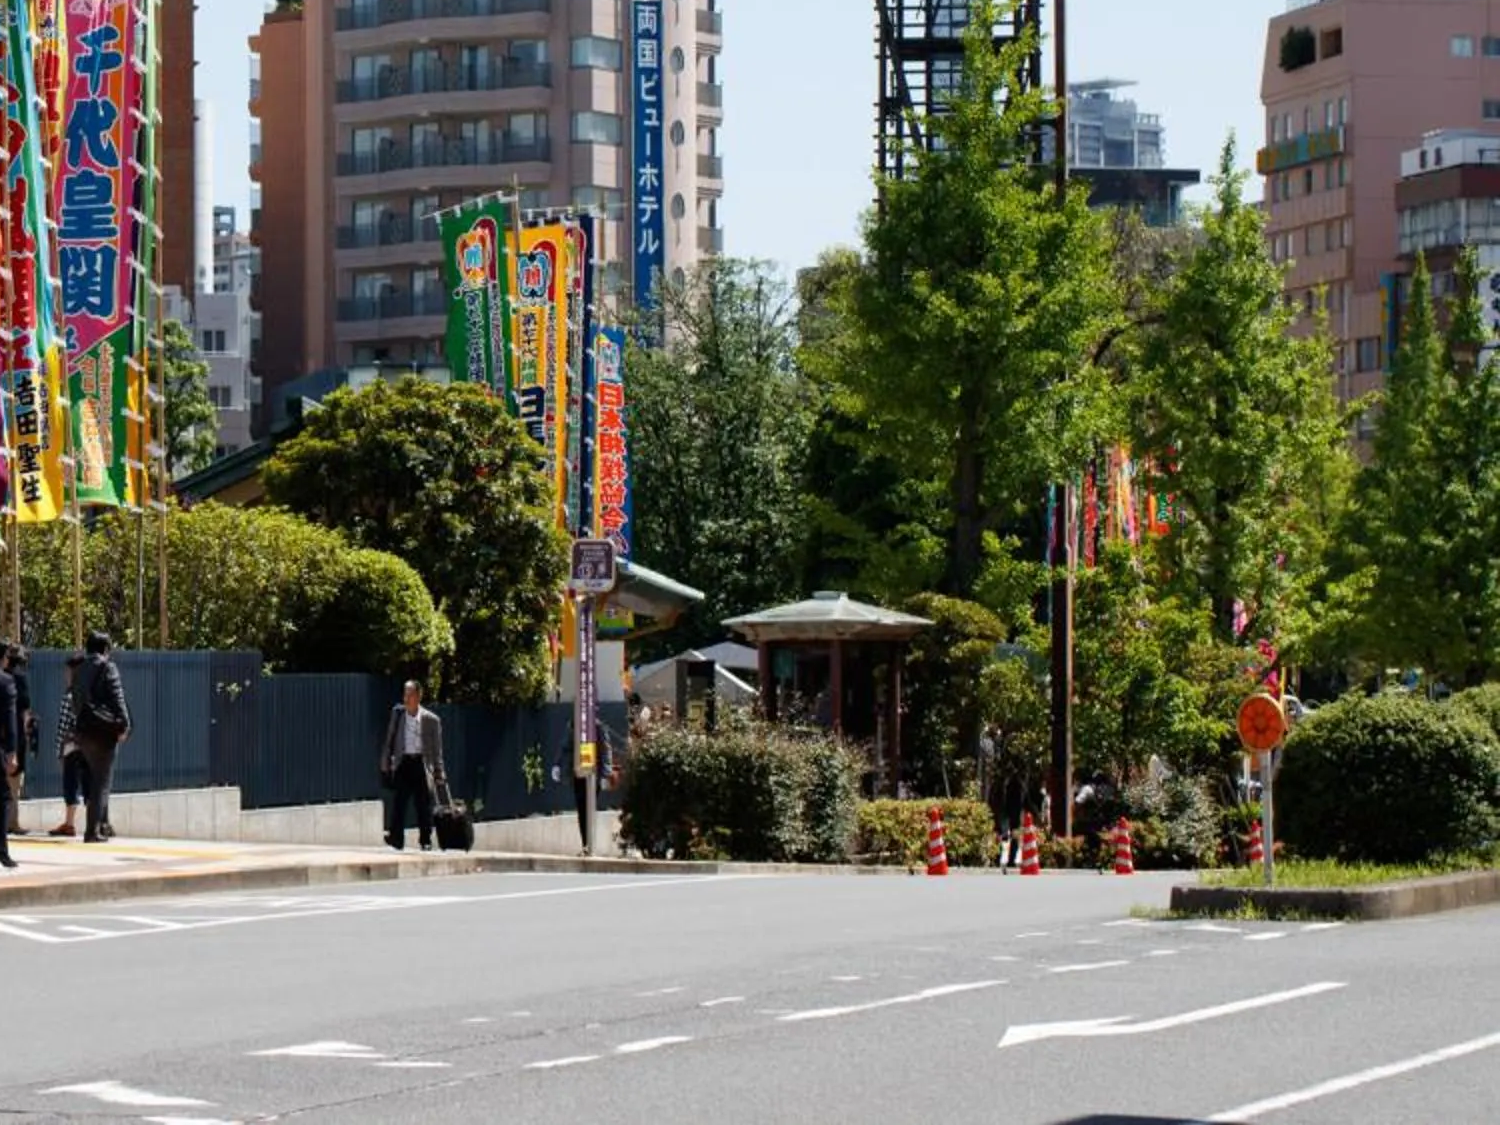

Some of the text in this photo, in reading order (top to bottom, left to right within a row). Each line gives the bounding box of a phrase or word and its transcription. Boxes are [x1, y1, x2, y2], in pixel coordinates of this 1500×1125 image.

[636, 5, 661, 254] 両国ビューホテル
[12, 373, 43, 507] 吉田聖生
